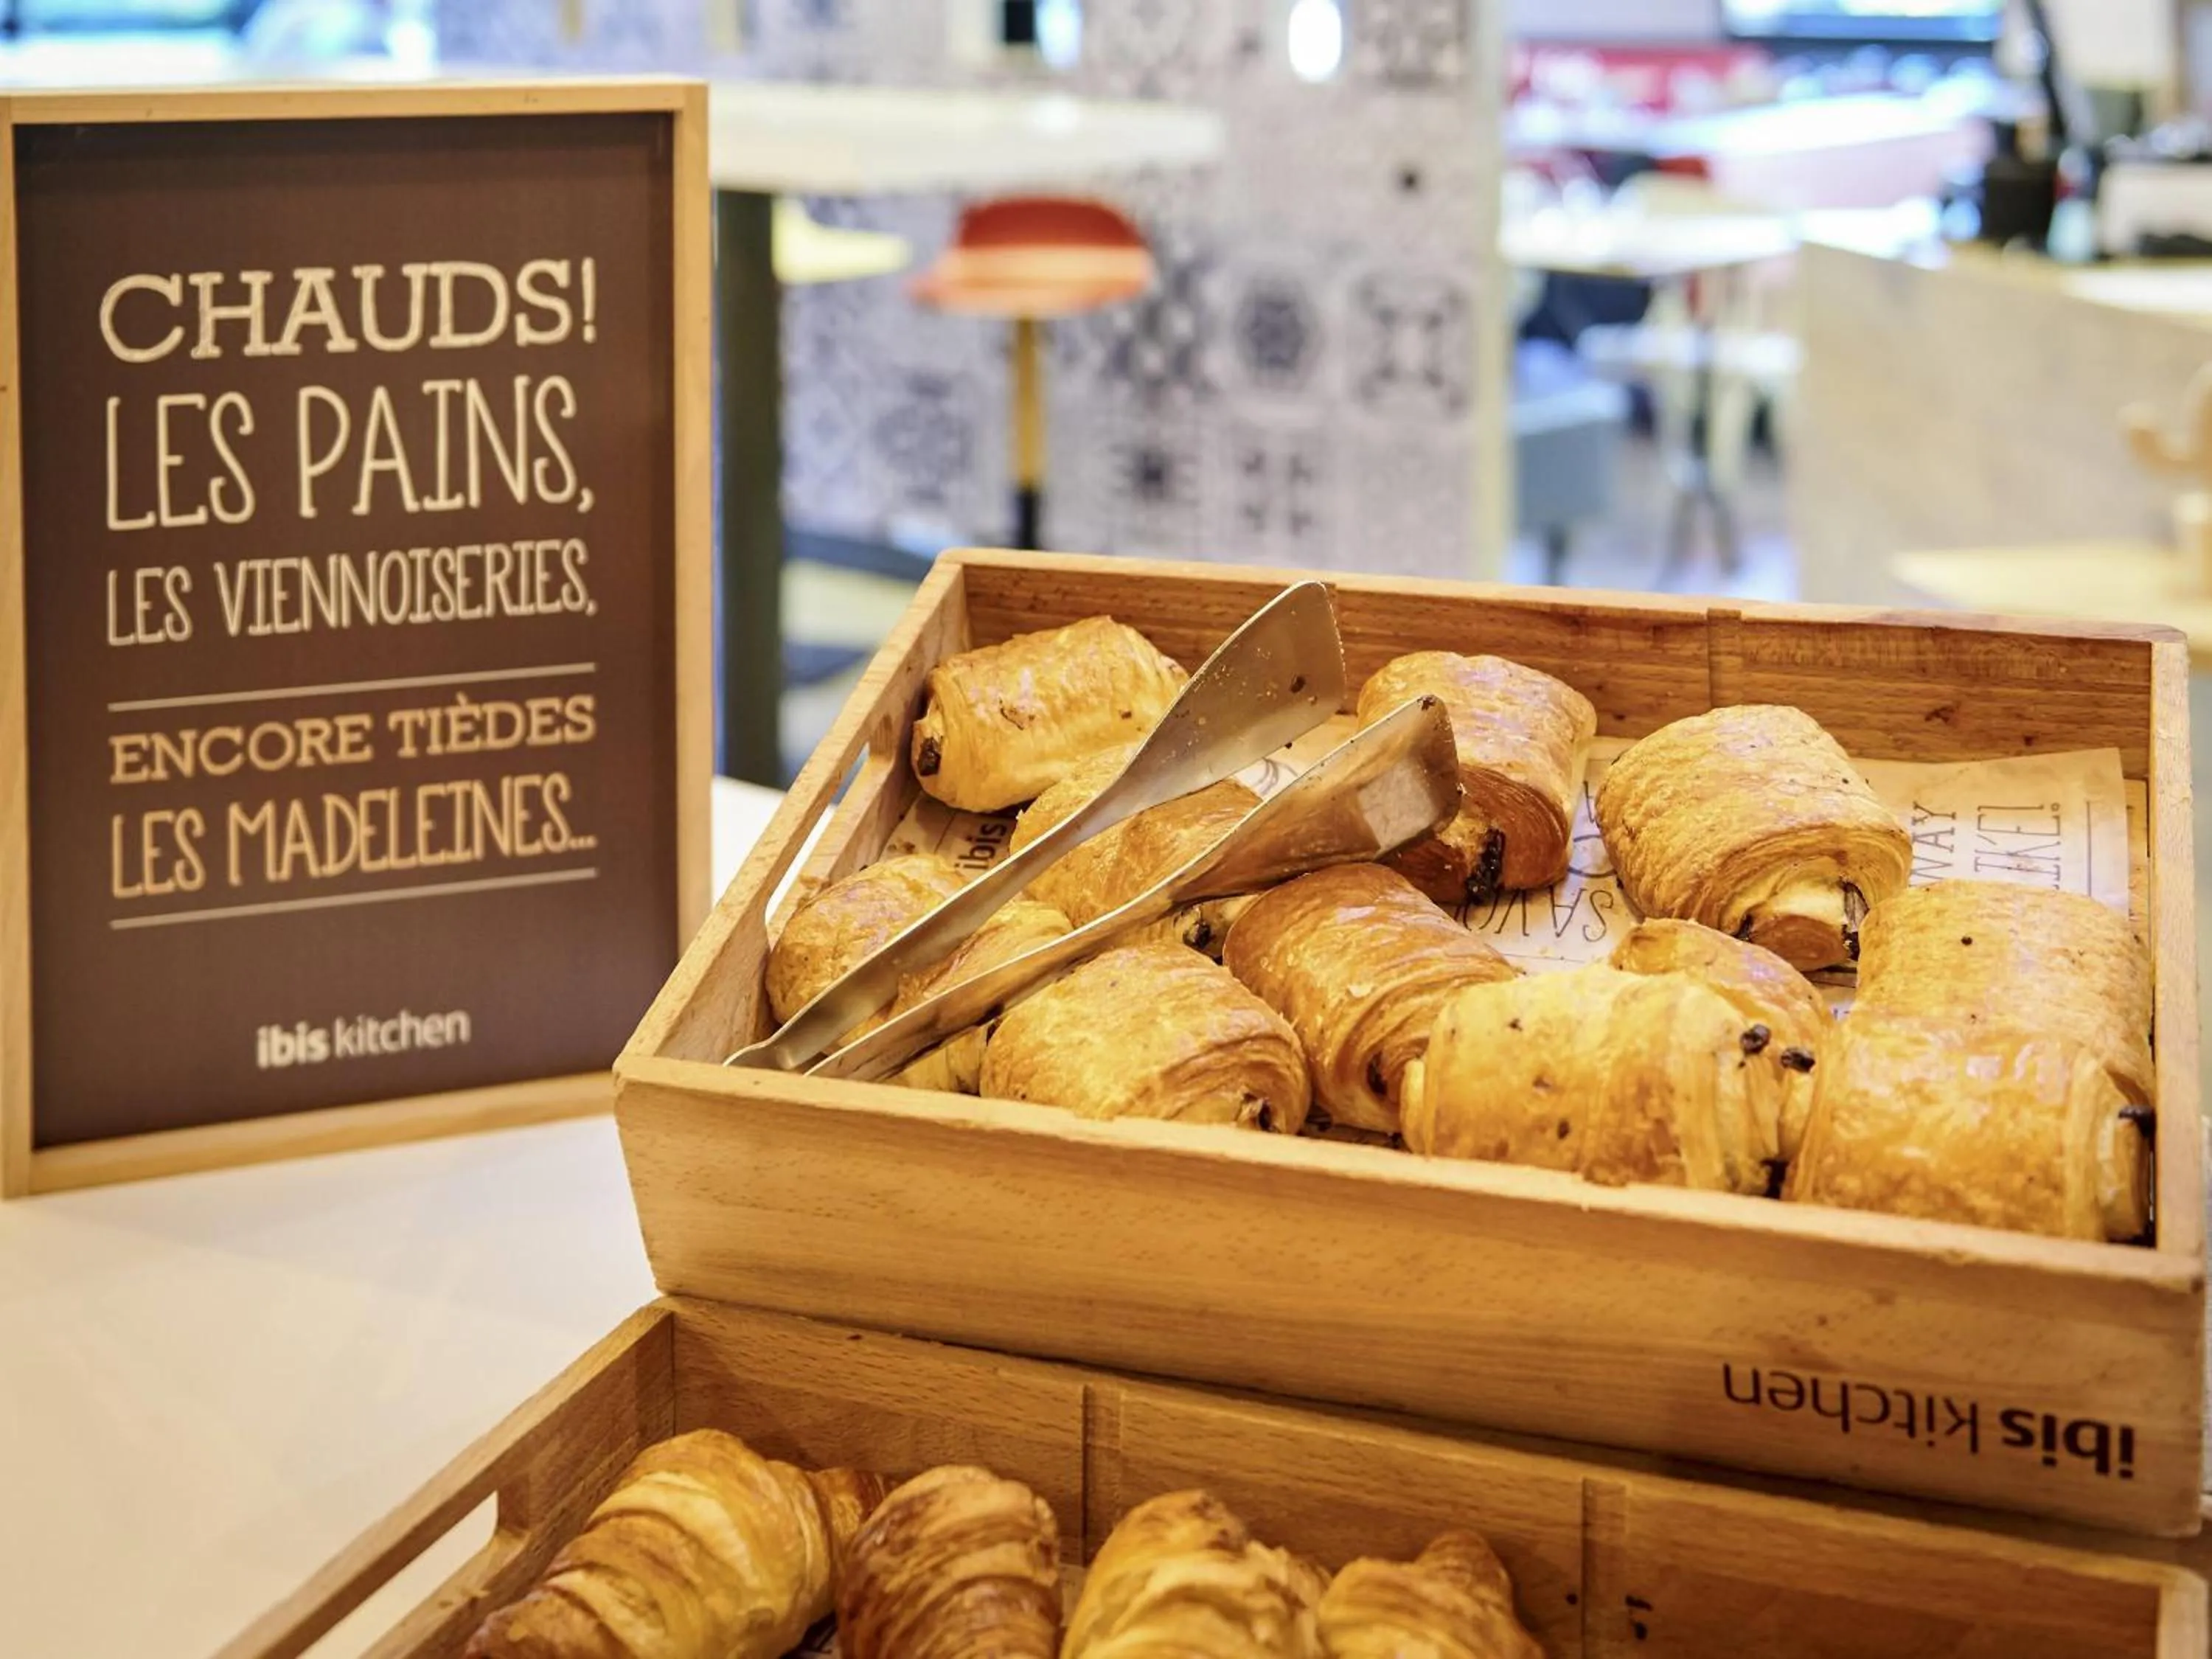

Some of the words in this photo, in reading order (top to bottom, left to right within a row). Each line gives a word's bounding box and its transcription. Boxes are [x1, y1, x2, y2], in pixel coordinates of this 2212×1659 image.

[100, 257, 596, 362] CHAUDS!
[107, 392, 255, 530] LES
[299, 375, 594, 518] PAINS,
[108, 566, 192, 646] LES
[214, 538, 597, 636] VIENNOISERIES,
[110, 714, 373, 784] ENCORE
[388, 692, 595, 757] TIÈDES
[112, 808, 206, 898] LES
[229, 773, 597, 886] MADELEINES...
[954, 822, 1008, 871] ibis
[1974, 801, 2062, 890] IKE!
[258, 1023, 329, 1068] ibis
[334, 1010, 470, 1059] kitchen
[1723, 1364, 1980, 1455] kitchen
[2000, 1409, 2135, 1479] ibis
